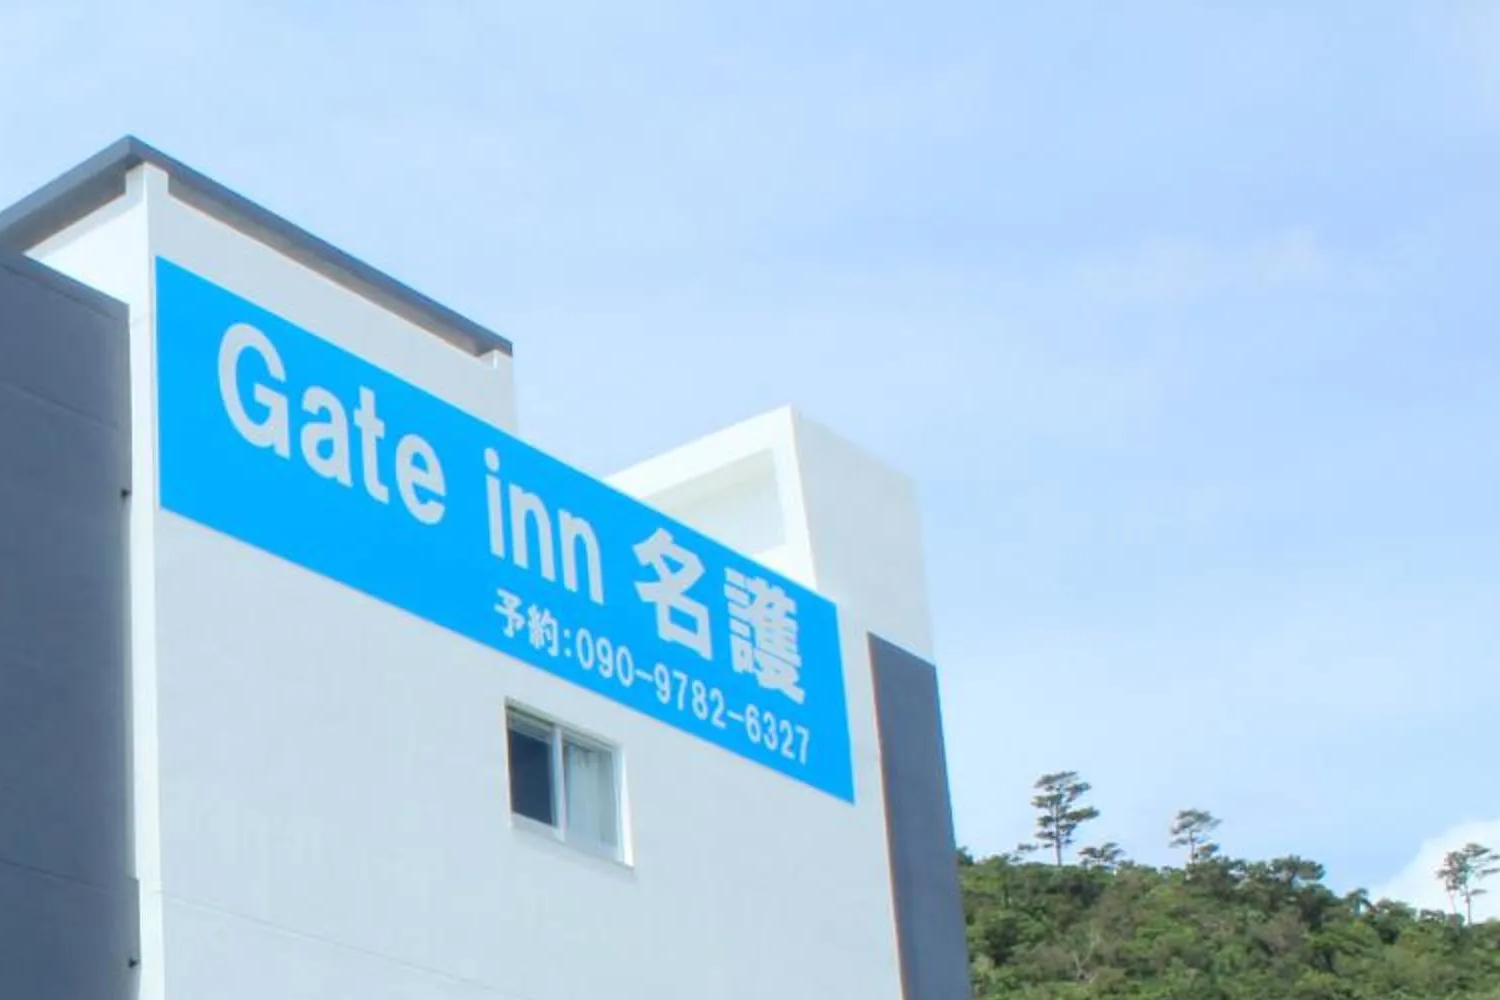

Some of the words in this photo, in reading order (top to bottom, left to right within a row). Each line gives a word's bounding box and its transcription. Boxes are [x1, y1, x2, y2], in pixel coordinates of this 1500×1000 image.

[218, 322, 447, 524] Gate
[484, 447, 604, 605] inn
[632, 527, 805, 705] 名護
